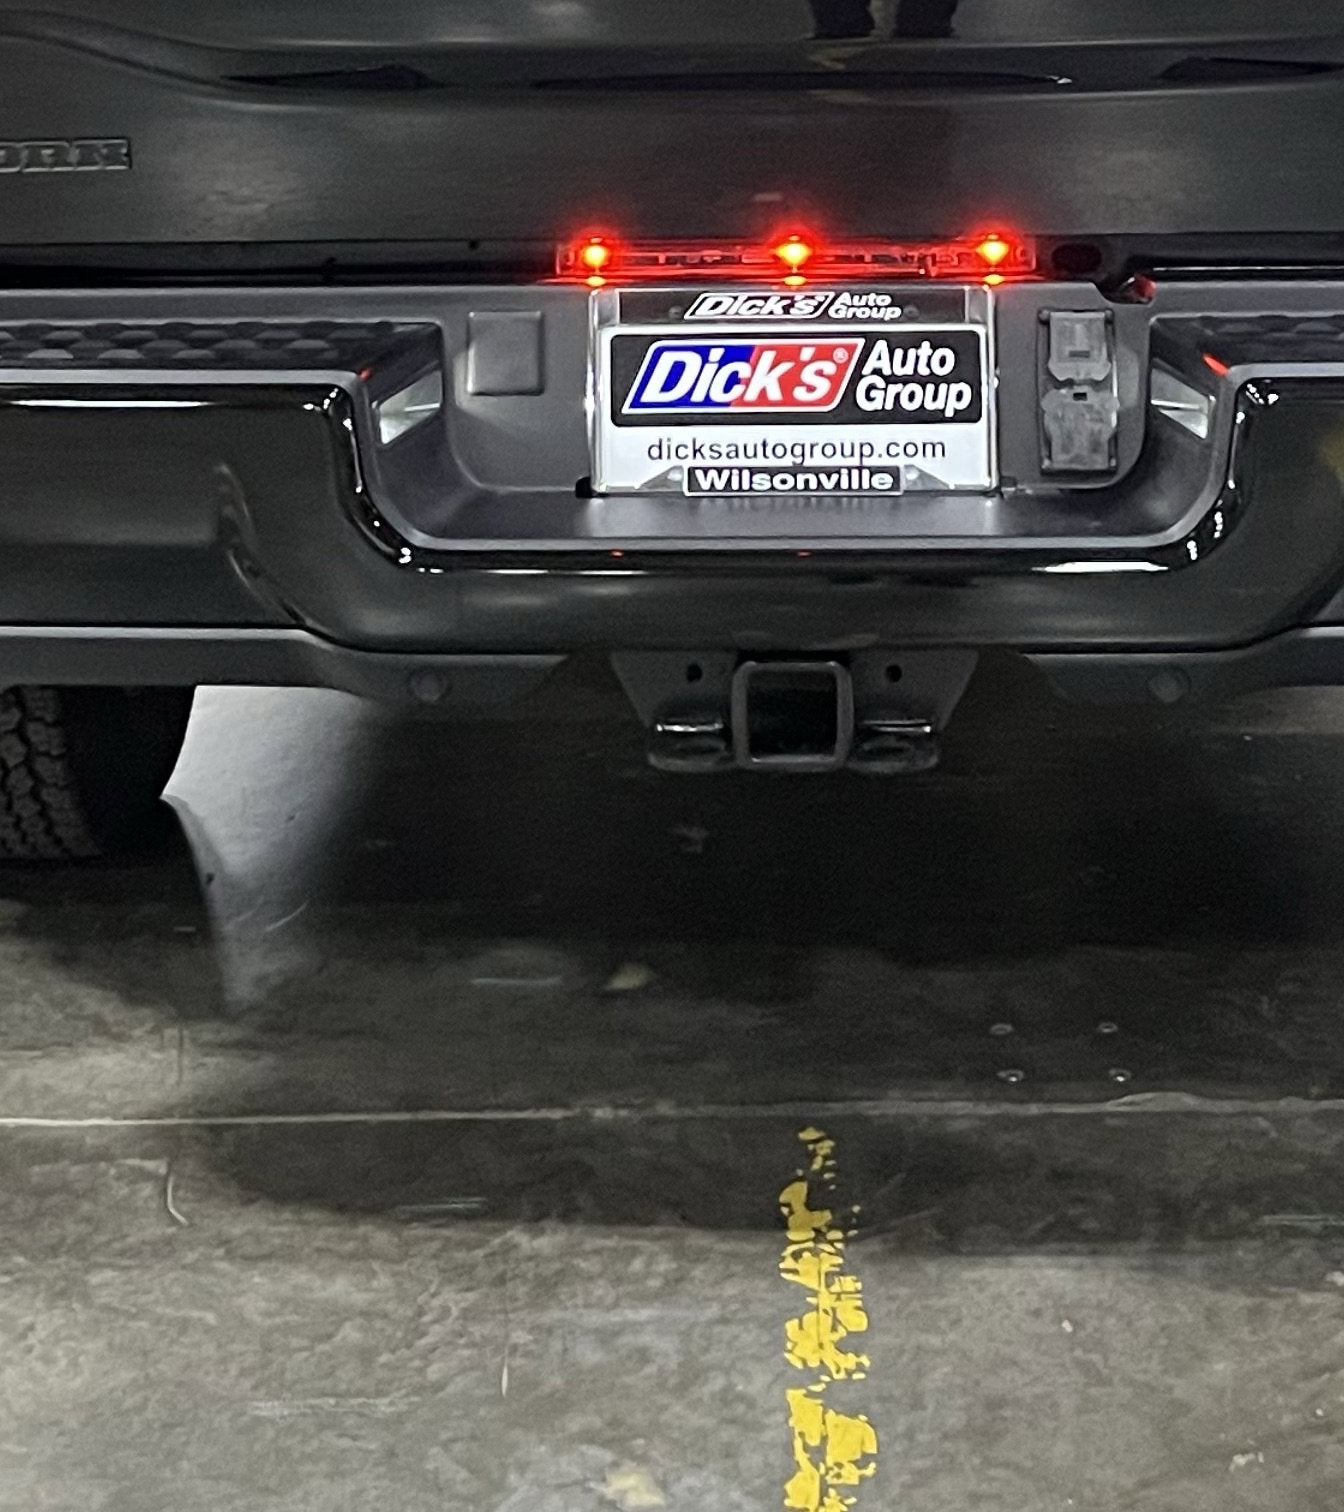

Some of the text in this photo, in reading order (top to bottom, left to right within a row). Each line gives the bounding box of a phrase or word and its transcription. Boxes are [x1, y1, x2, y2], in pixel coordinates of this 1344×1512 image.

[693, 294, 826, 316] Dick's
[828, 304, 902, 321] Group
[835, 292, 892, 307] Auto
[861, 339, 956, 377] Auto
[639, 346, 837, 404] Dick's
[854, 375, 973, 418] Group
[647, 438, 946, 467] dicksautogroup.com
[695, 468, 895, 491] Wilsonville
